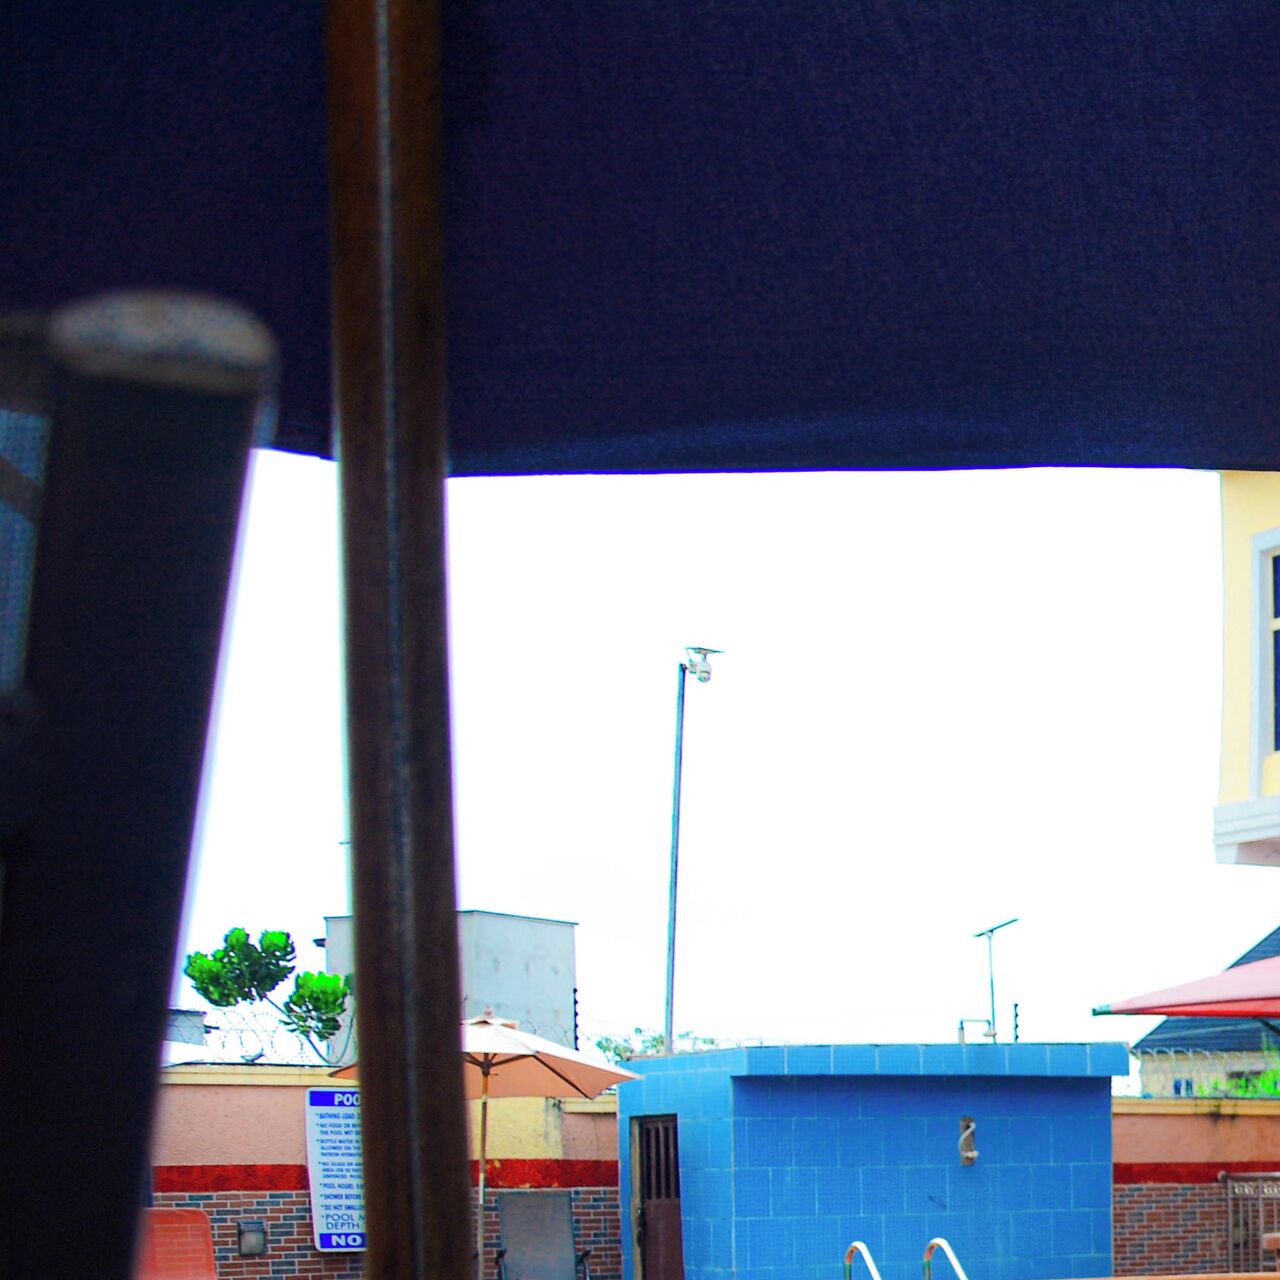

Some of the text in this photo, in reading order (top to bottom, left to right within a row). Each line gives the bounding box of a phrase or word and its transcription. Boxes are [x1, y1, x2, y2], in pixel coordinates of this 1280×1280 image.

[334, 1093, 361, 1106] POO
[325, 1213, 355, 1221] POOL
[326, 1222, 360, 1230] DEPTH
[331, 1235, 362, 1246] NO
